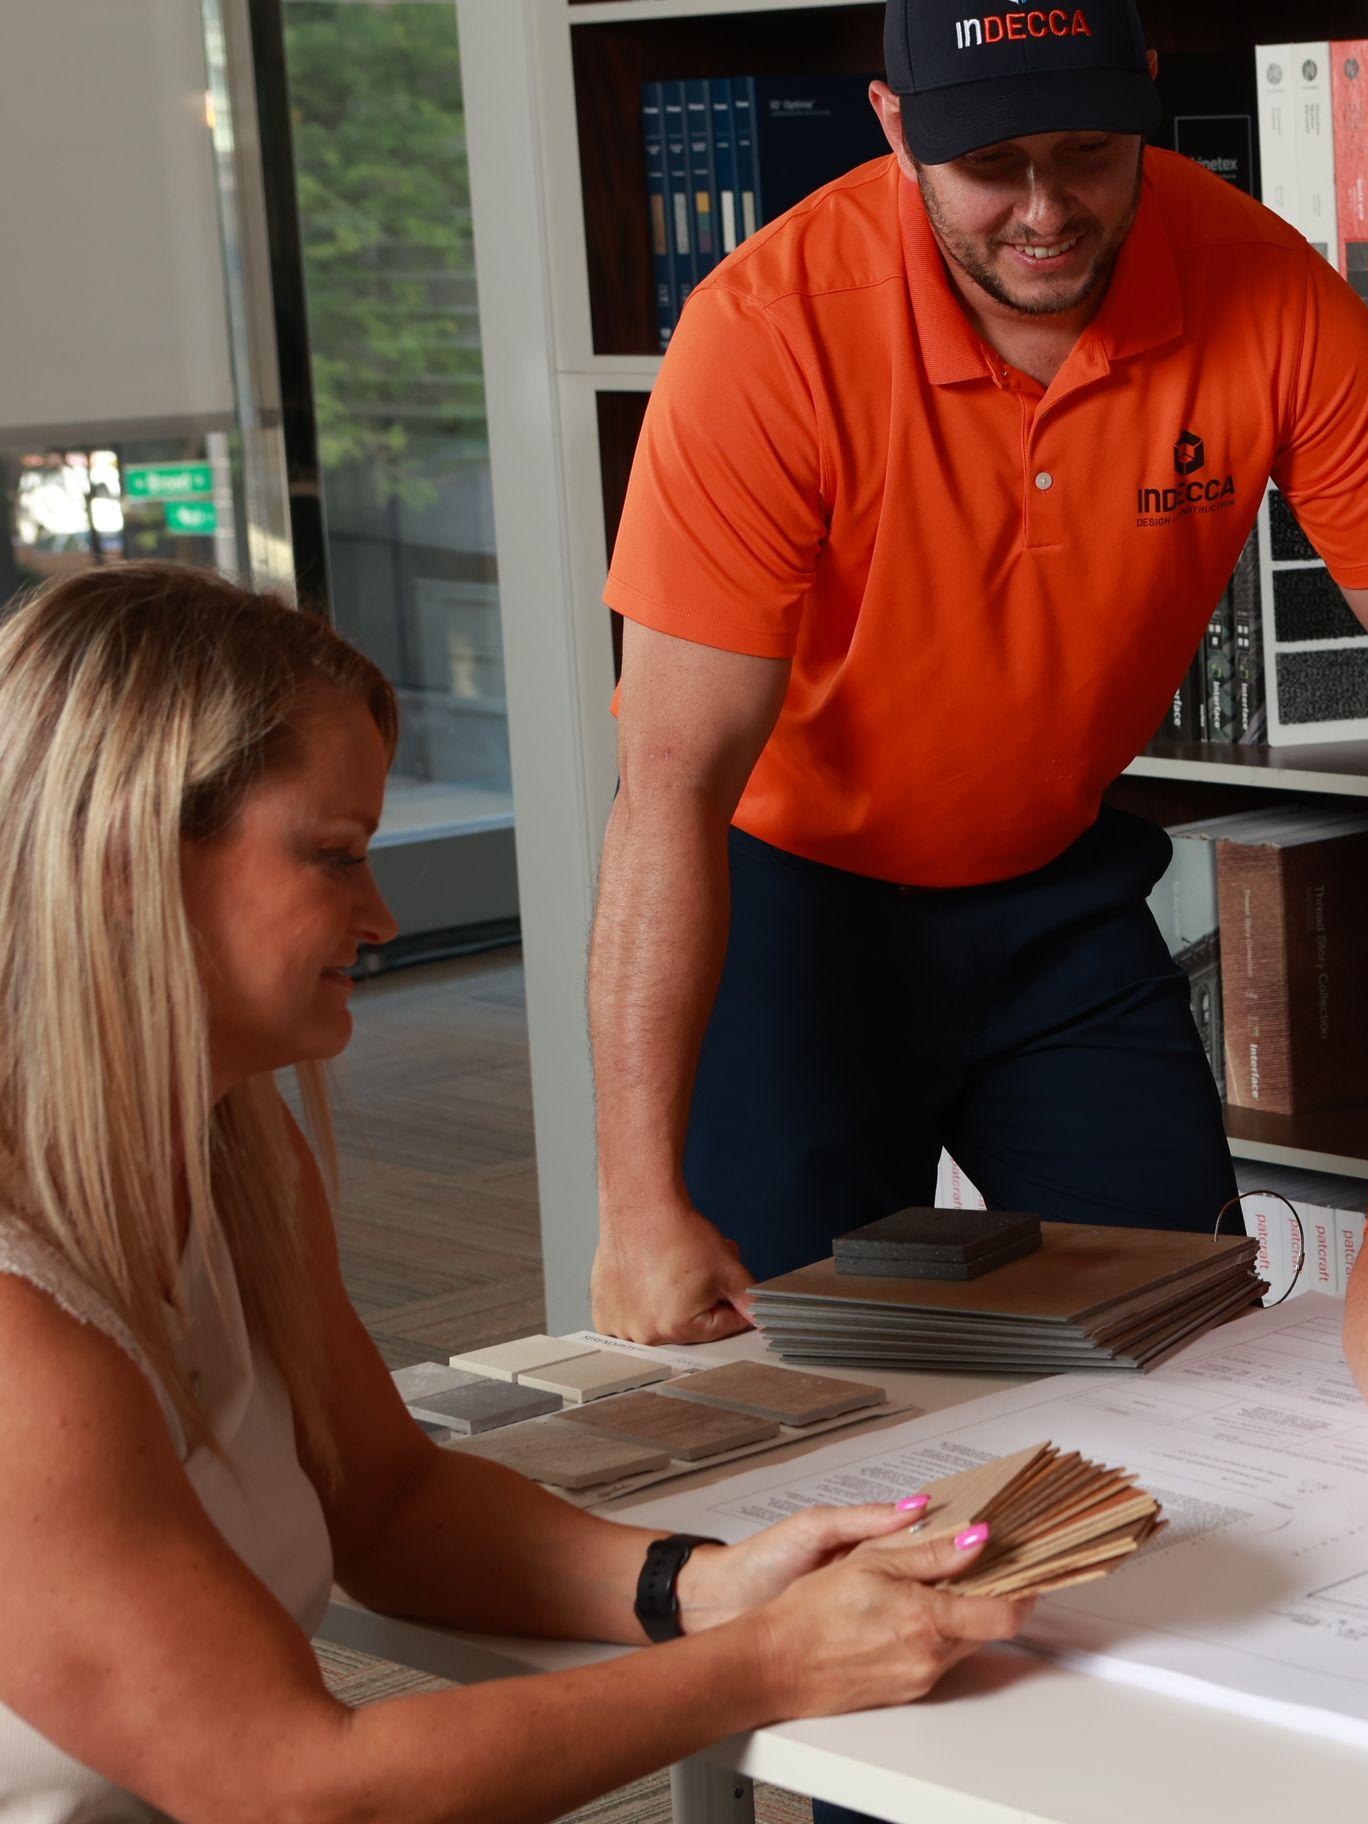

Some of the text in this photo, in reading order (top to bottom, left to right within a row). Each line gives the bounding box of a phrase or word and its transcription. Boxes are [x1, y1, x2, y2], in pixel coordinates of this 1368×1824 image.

[1136, 517, 1171, 527] DESIGN
[1213, 681, 1221, 729] Interface
[1240, 682, 1249, 731] Interface
[1313, 884, 1329, 1040] Thread Story Collection
[1249, 1043, 1260, 1099] Interface
[1314, 1224, 1330, 1283] patcraft
